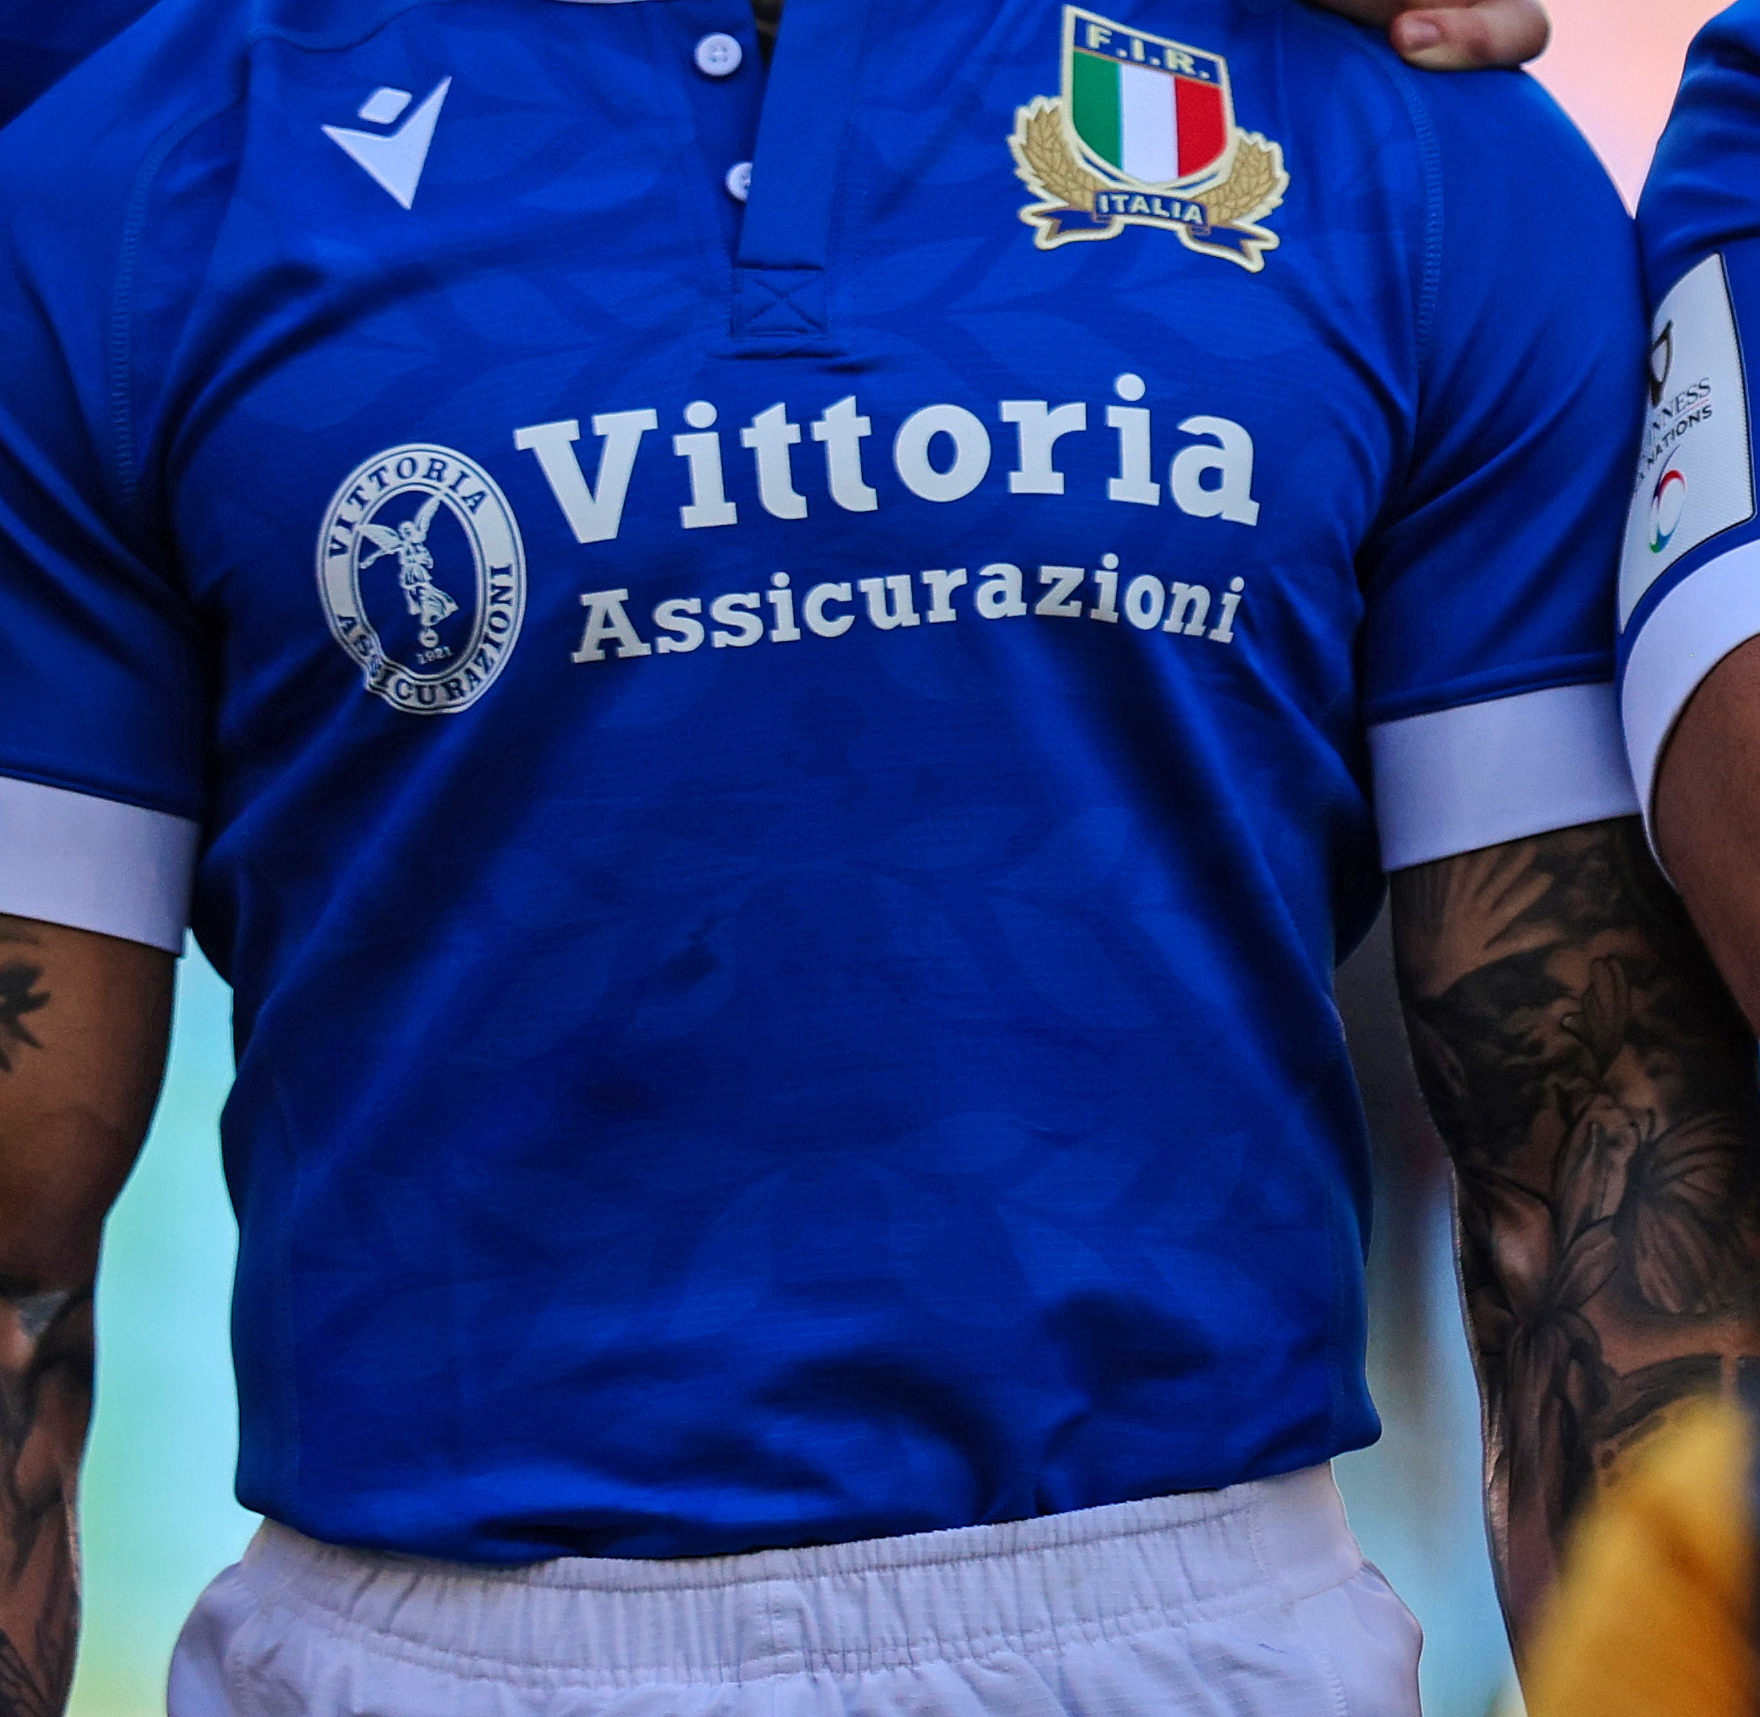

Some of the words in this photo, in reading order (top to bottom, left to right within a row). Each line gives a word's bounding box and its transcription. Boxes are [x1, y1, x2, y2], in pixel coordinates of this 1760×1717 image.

[1086, 23, 1210, 80] F.I.R.
[1098, 194, 1204, 226] ITALIA
[327, 456, 490, 559] VITTORIA
[514, 372, 1260, 544] Vittoria
[572, 553, 1245, 664] Assicurazioni
